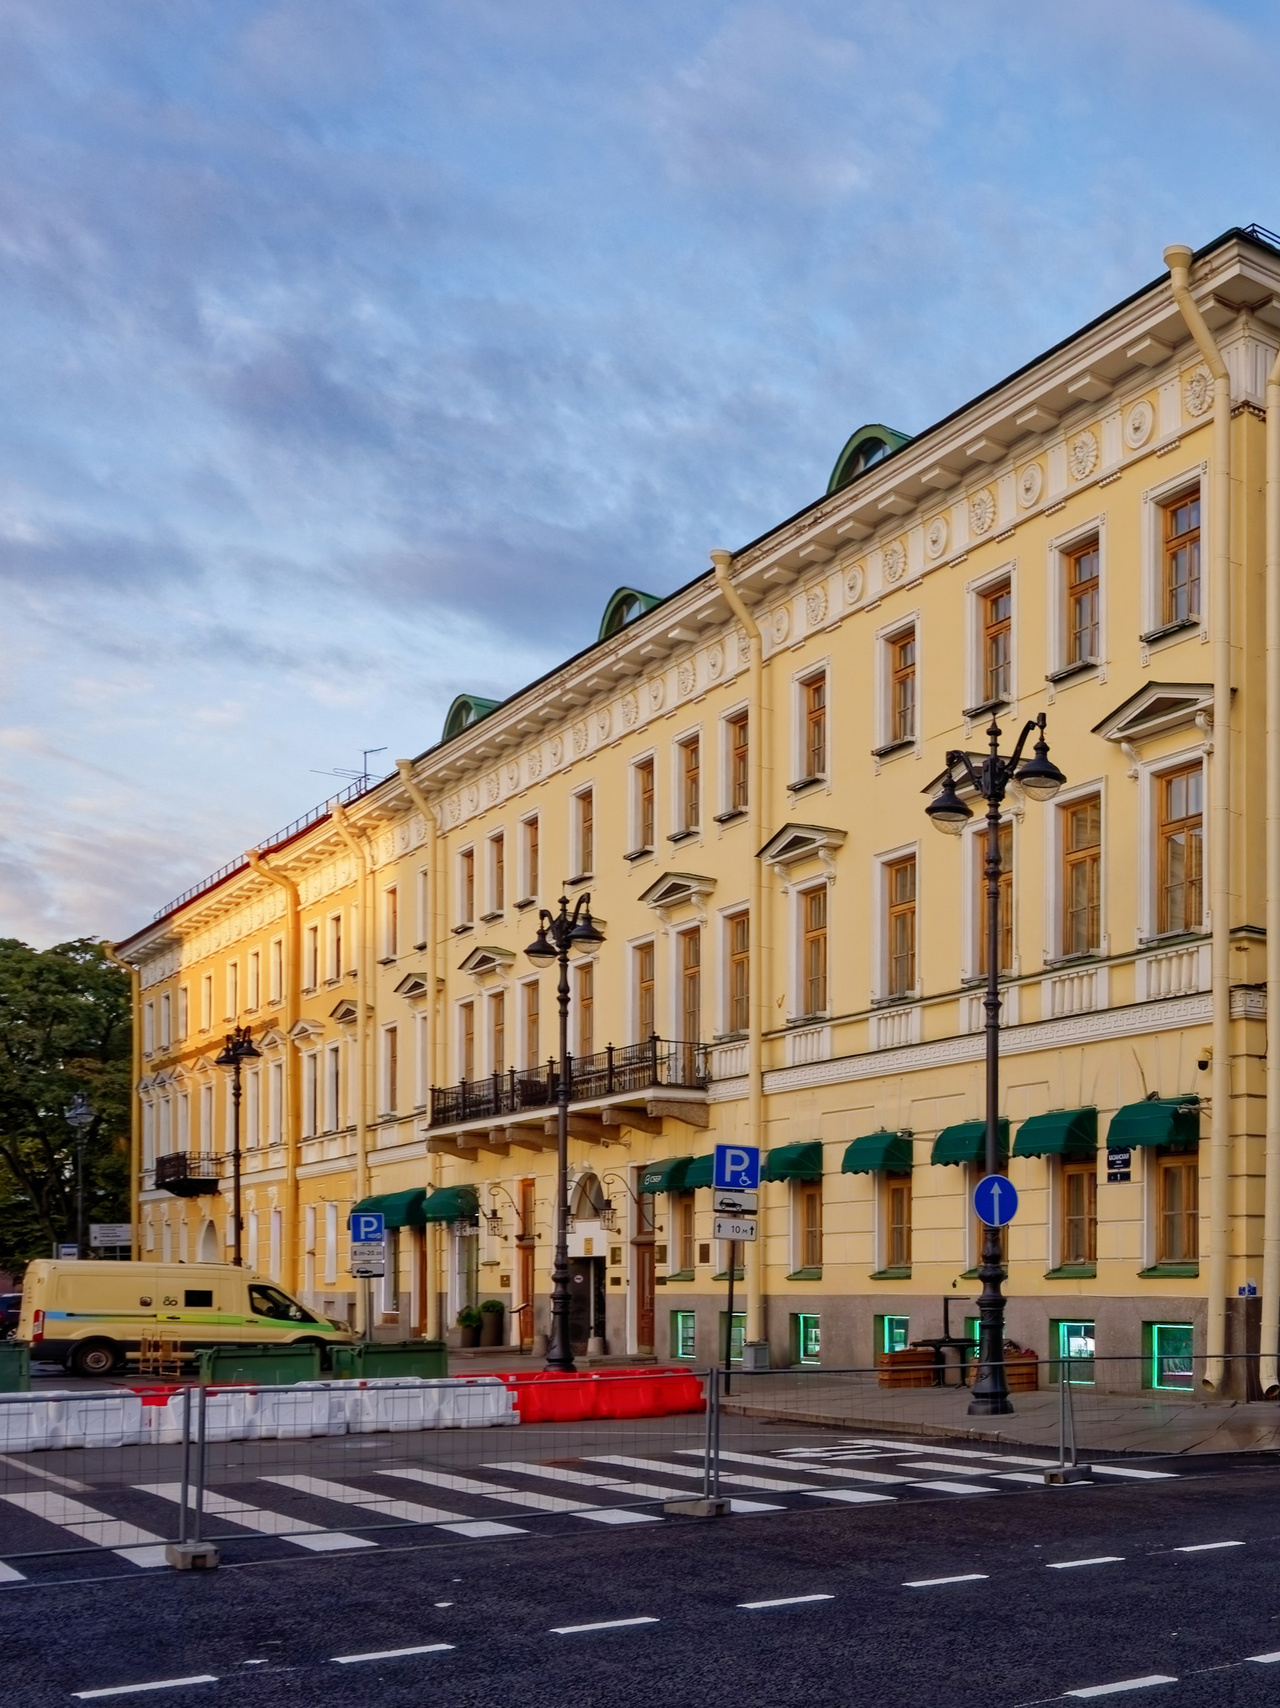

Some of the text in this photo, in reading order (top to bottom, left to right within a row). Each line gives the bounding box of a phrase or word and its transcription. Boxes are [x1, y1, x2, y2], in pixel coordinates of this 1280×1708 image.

[724, 1148, 750, 1183] P
[360, 1216, 378, 1240] P
[731, 1225, 741, 1234] 10
